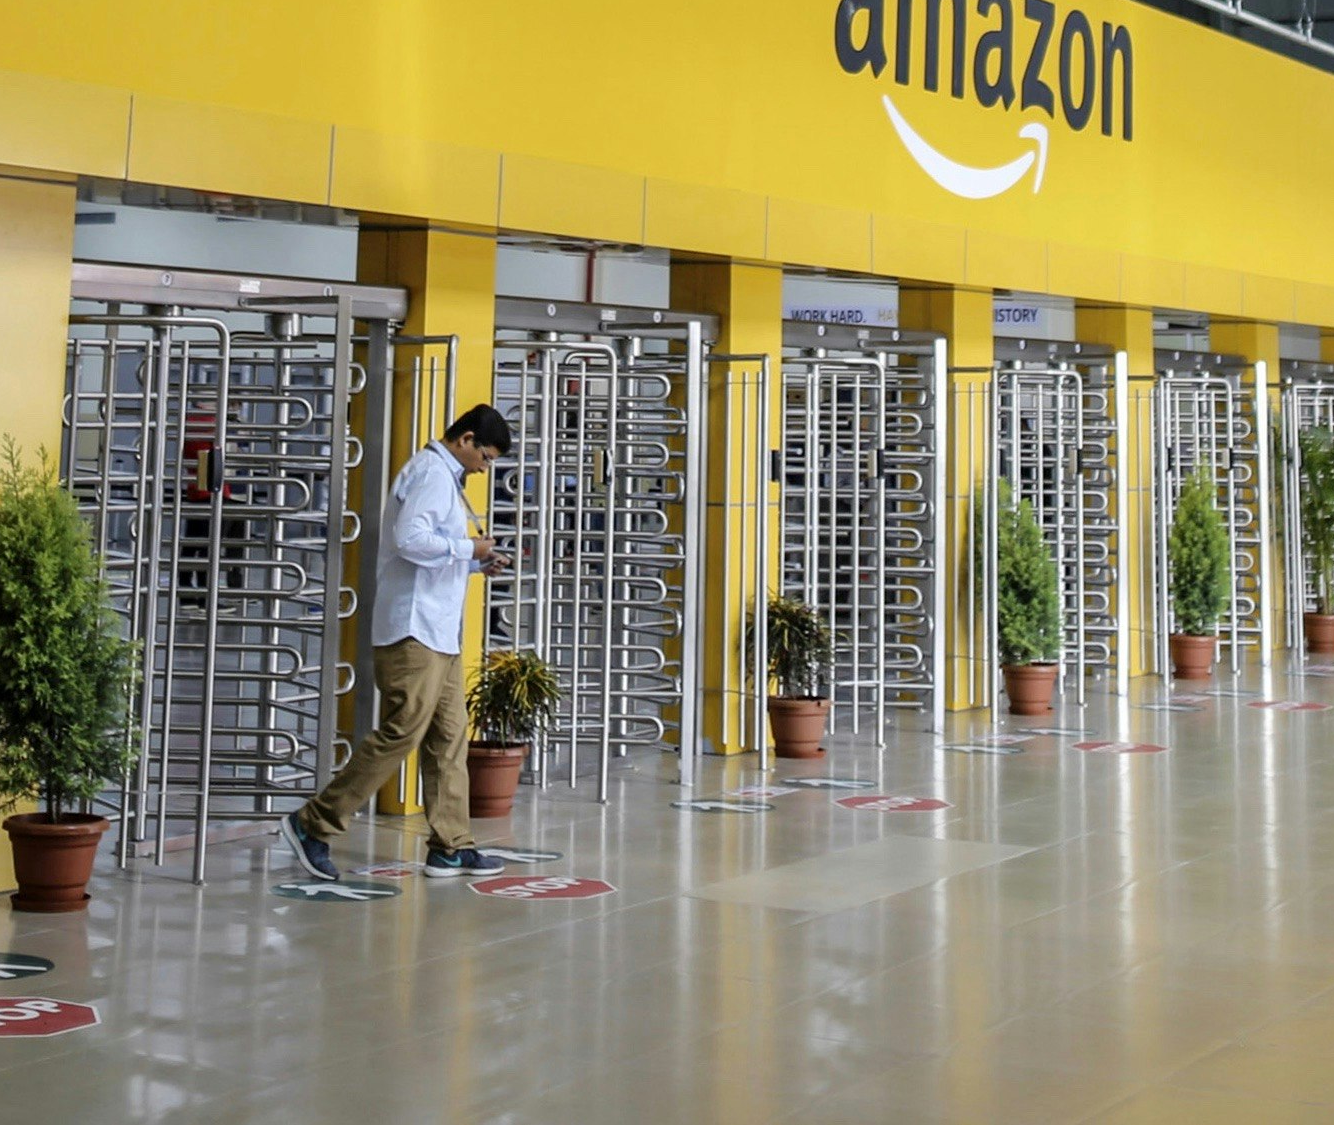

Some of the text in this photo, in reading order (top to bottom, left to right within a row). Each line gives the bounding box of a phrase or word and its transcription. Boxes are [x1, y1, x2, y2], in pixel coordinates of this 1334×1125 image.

[791, 310, 827, 323] WORK
[830, 310, 867, 324] HARD.
[493, 877, 581, 897] STOP
